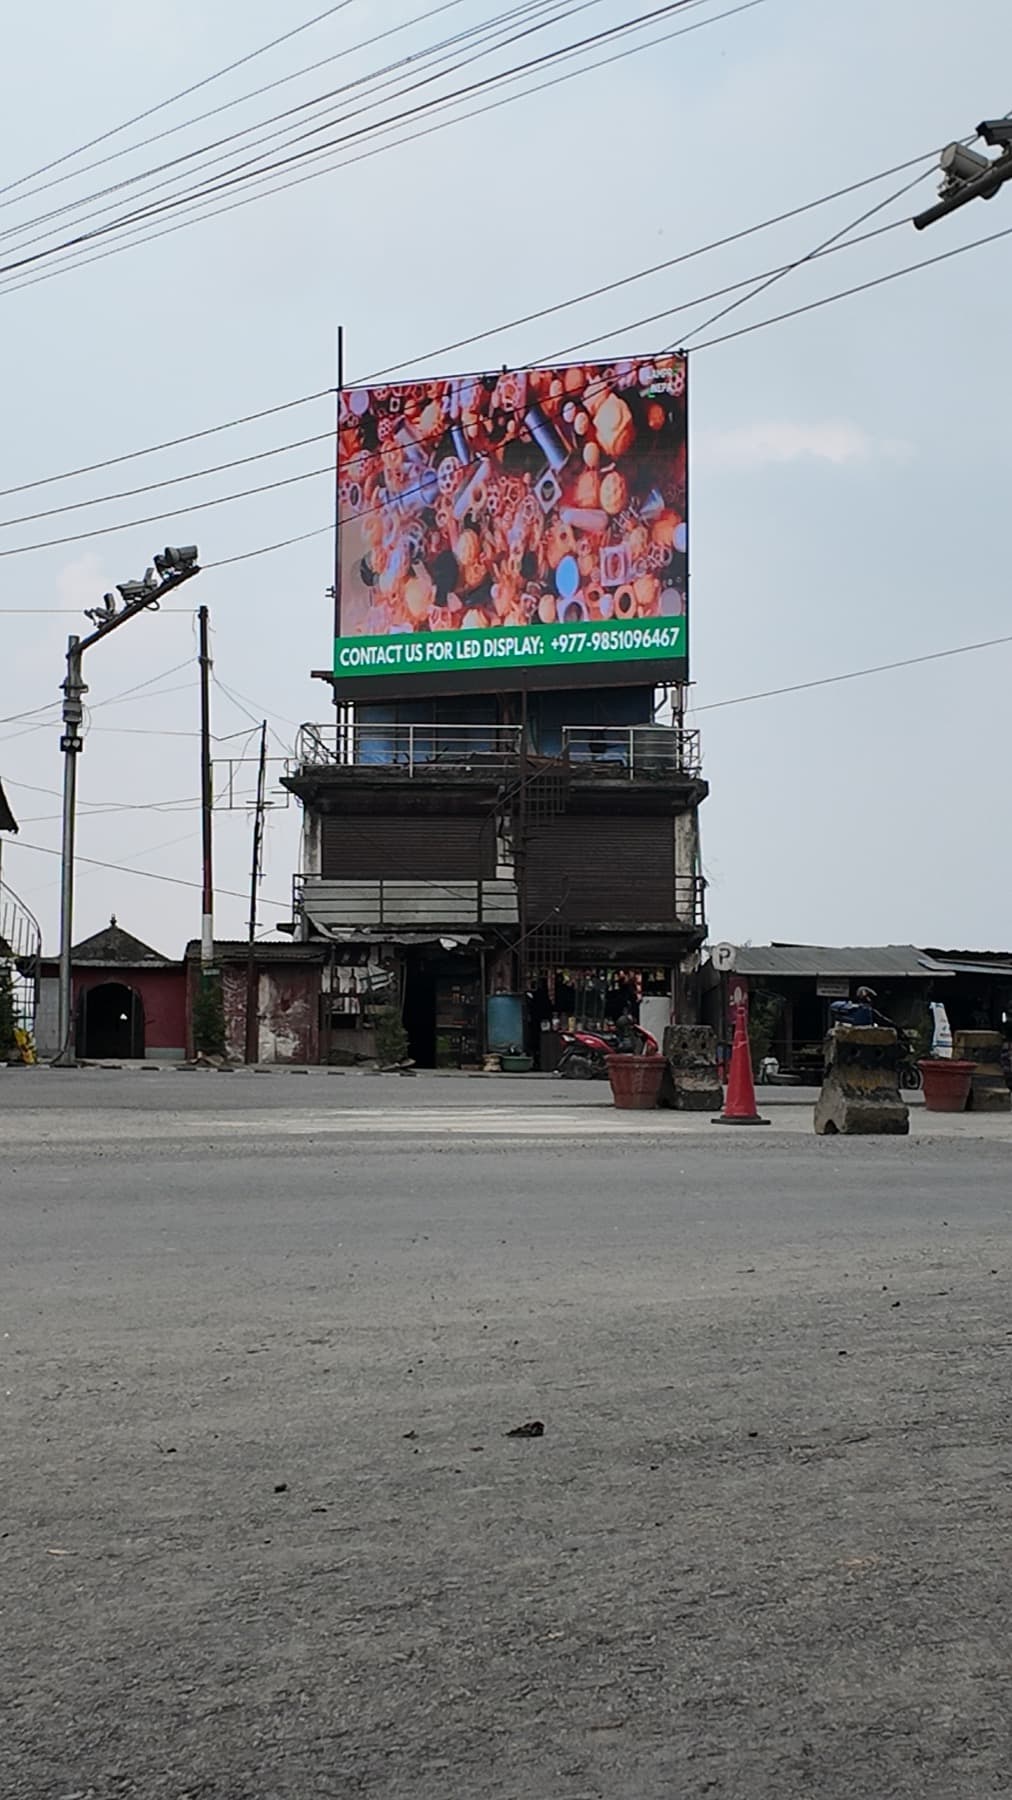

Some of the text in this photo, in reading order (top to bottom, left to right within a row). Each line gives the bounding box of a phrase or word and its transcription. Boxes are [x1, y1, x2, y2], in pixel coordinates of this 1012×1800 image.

[339, 627, 681, 666] CONTACT US FOR LED DISPLAY: +977-9851096467
[719, 947, 731, 965] P
